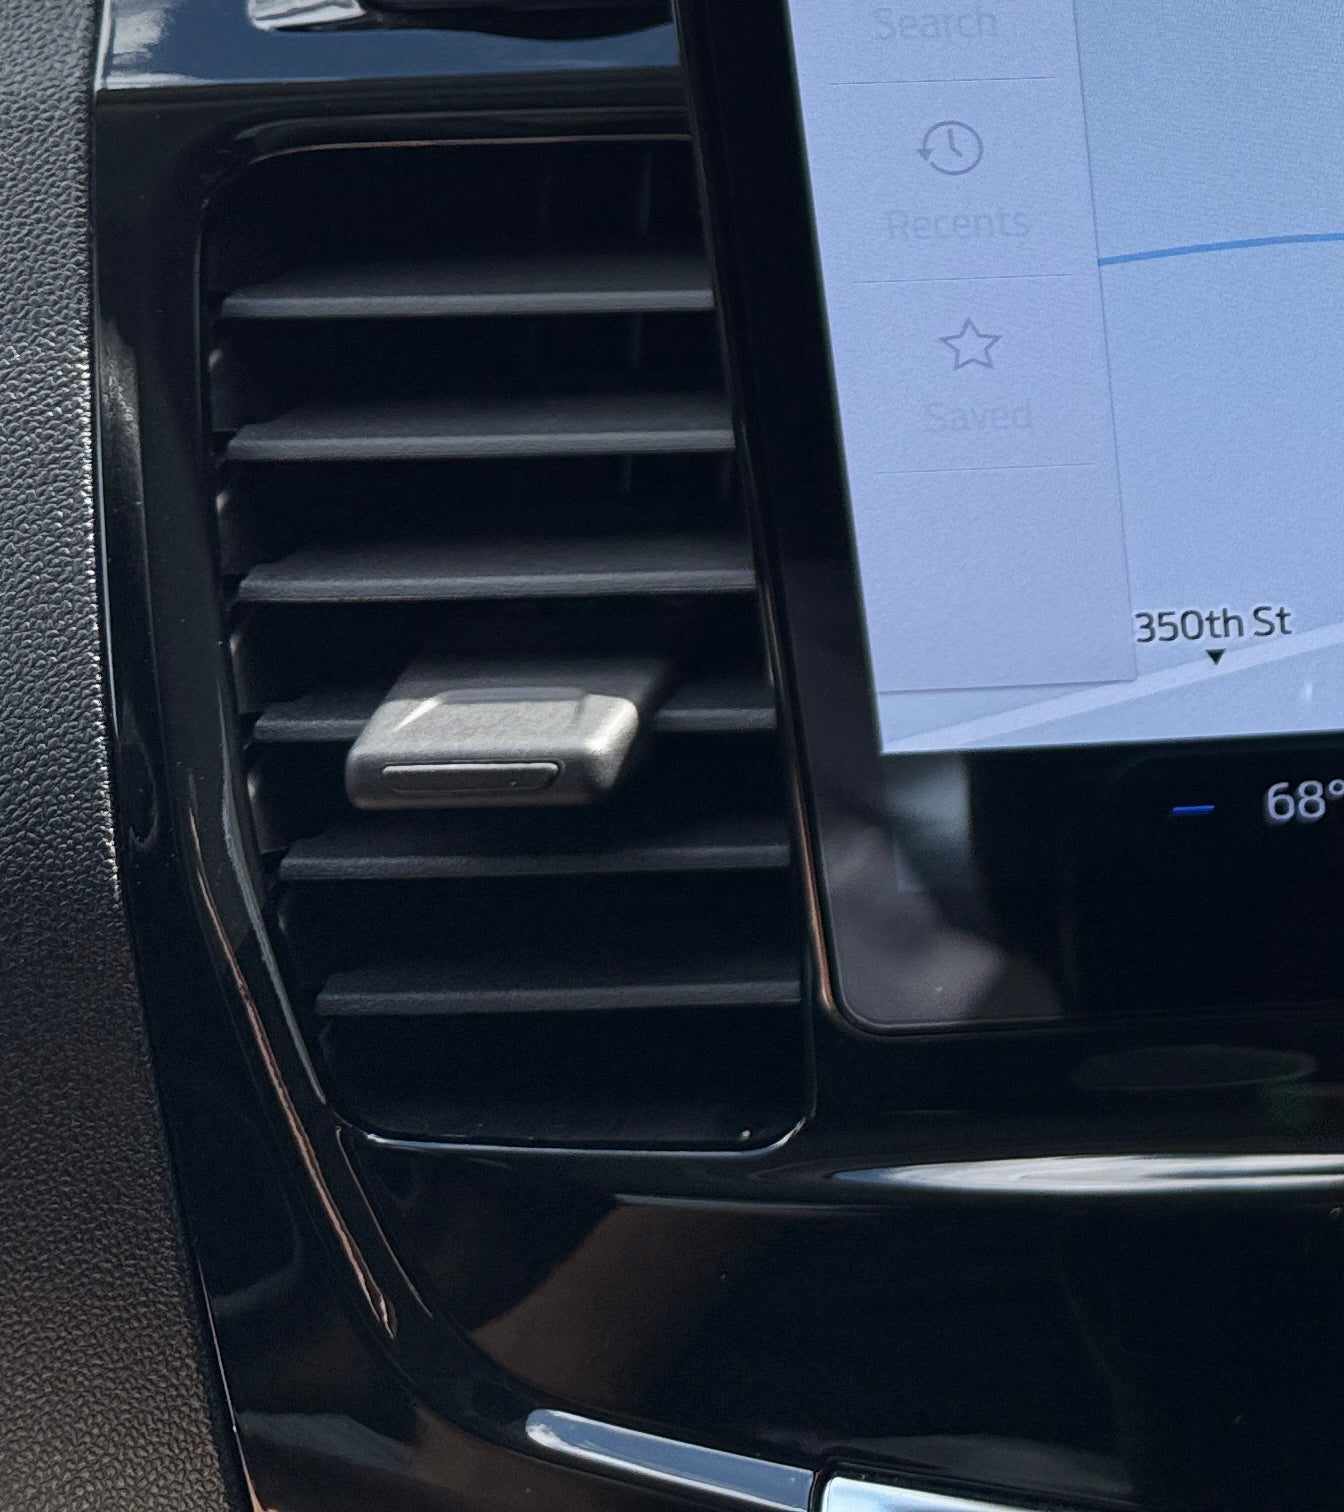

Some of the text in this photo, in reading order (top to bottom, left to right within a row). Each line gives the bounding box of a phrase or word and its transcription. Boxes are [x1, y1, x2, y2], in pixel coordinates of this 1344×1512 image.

[872, 5, 997, 41] Search
[886, 207, 1031, 240] Recents
[923, 398, 1034, 432] Saved
[1134, 605, 1293, 643] 350th St
